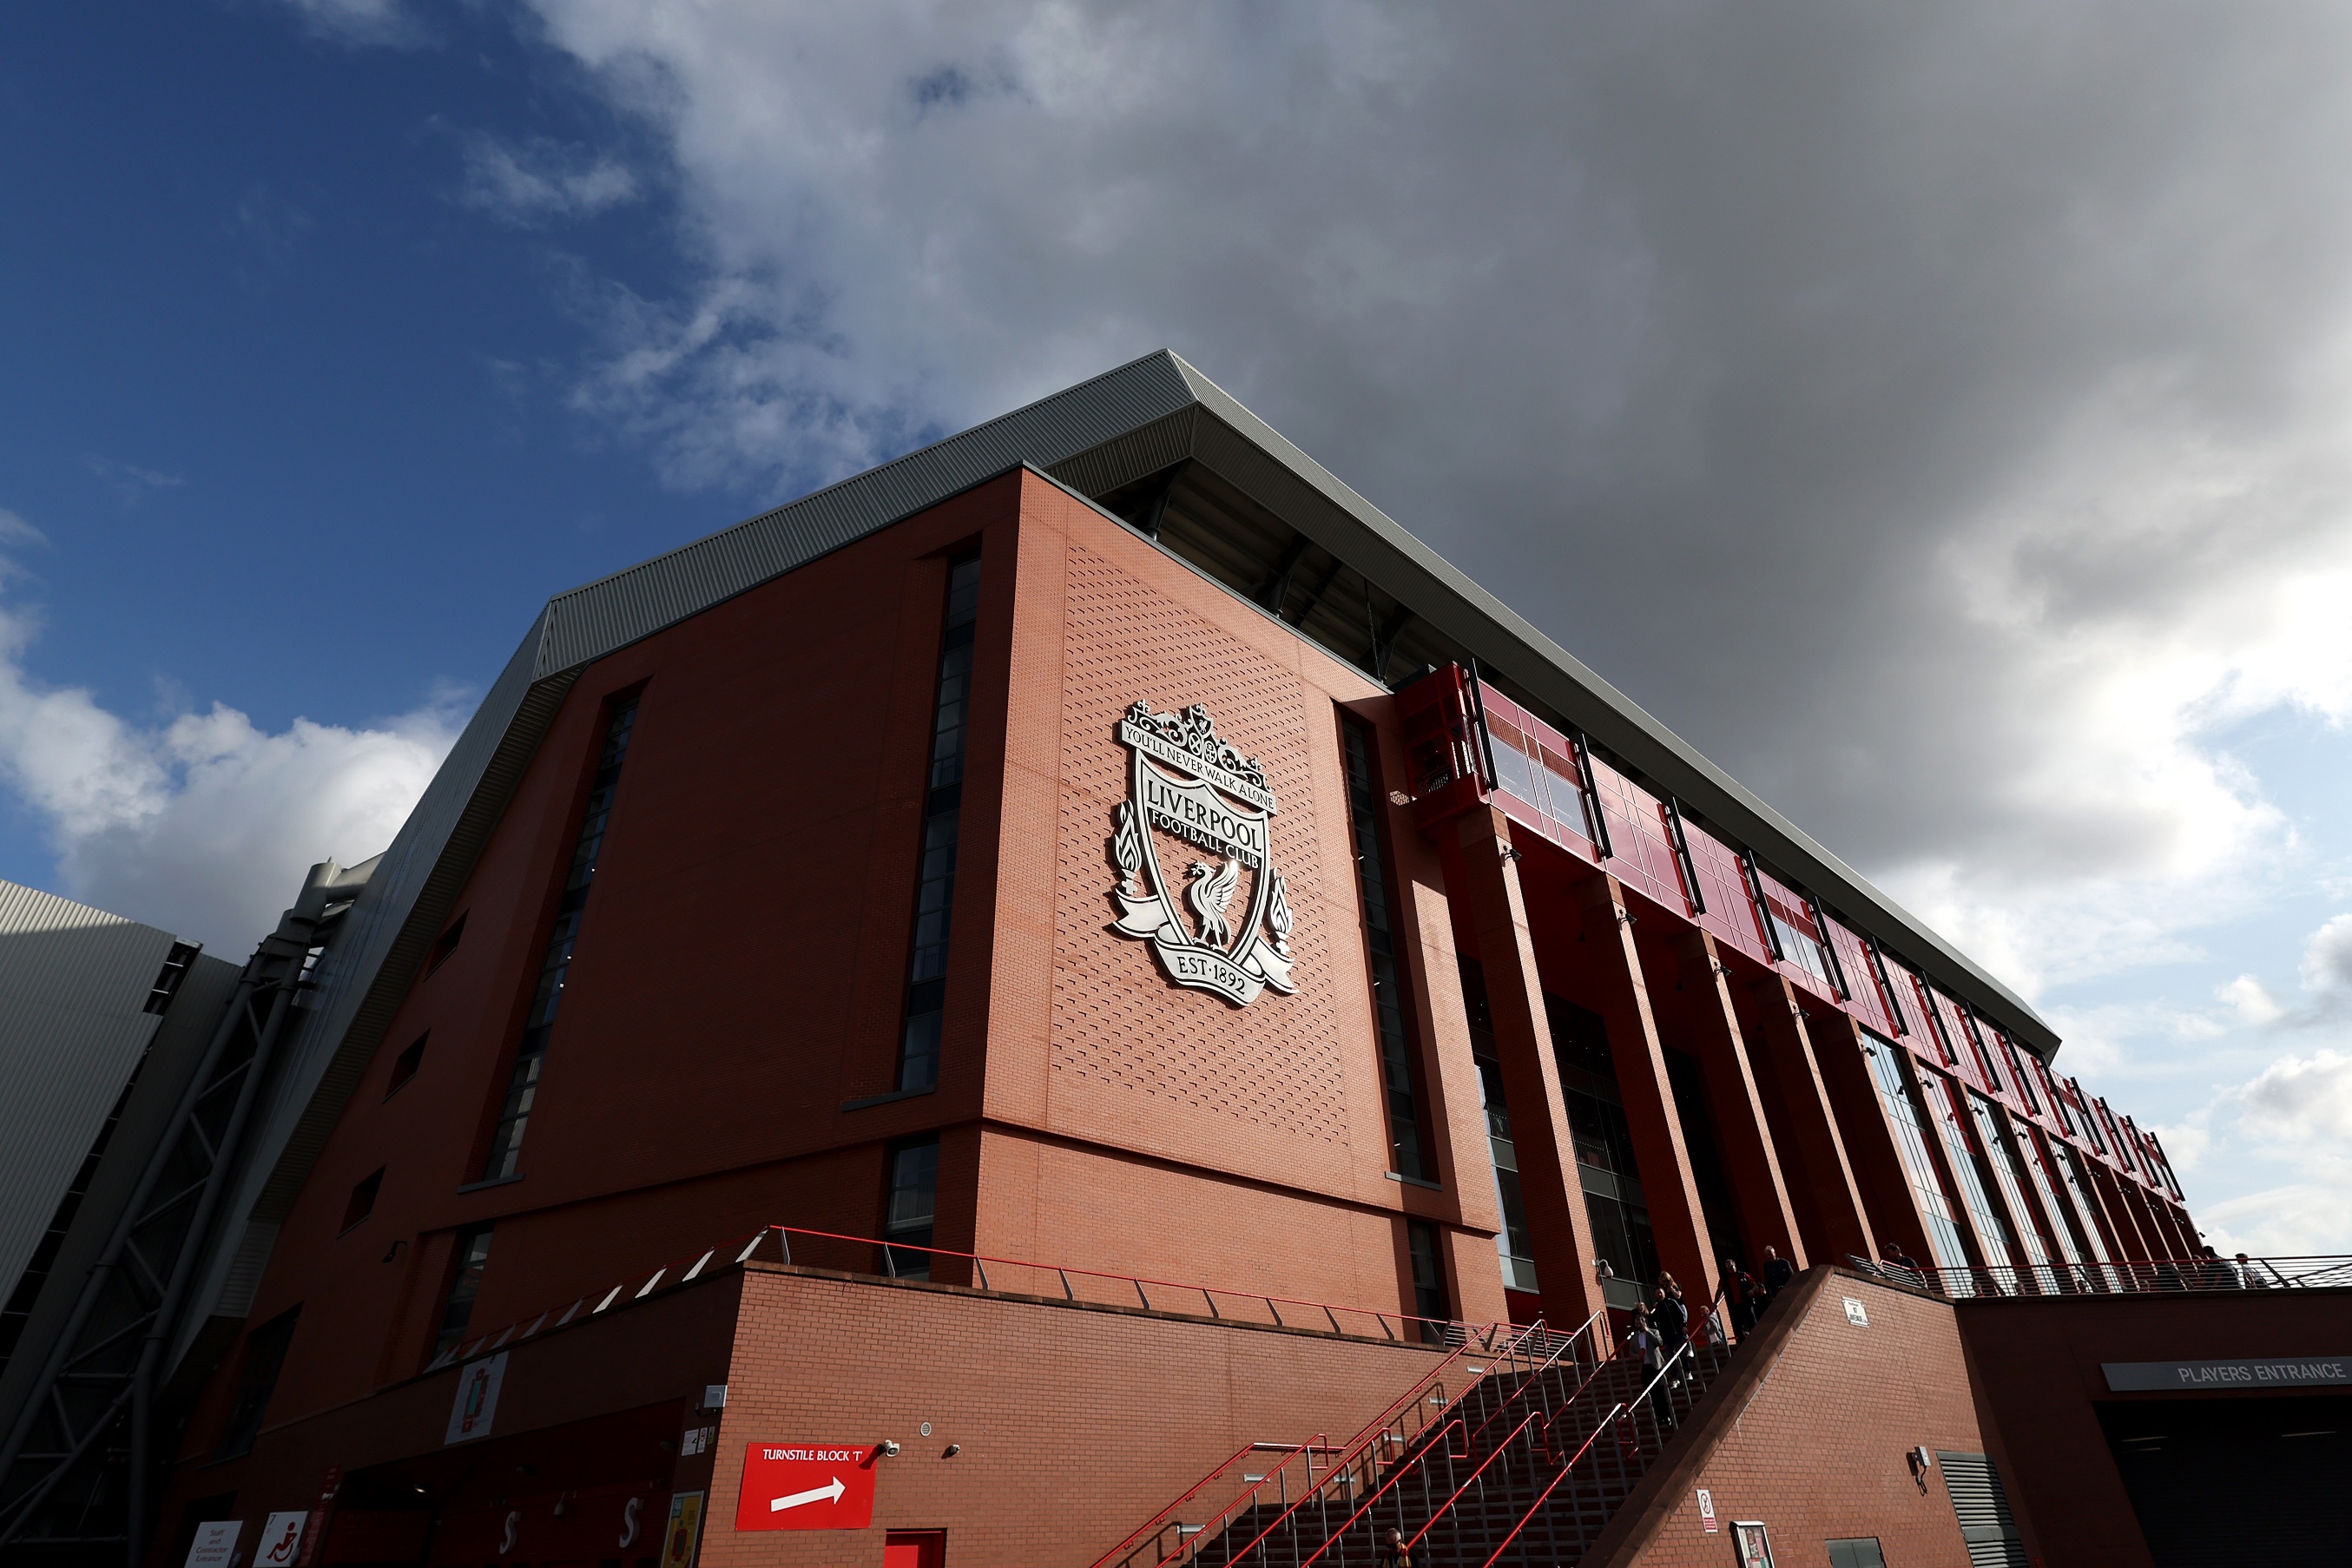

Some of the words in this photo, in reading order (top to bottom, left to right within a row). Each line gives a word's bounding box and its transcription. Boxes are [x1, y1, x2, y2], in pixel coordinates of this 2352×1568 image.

[1125, 726, 1164, 755] YOU'LL
[1167, 747, 1204, 775] NEVER
[1205, 766, 1236, 791] WALK
[1239, 784, 1274, 809] ALONE
[1148, 780, 1262, 853] LIVERPOOL
[1152, 810, 1222, 853] FOOTBALL
[1226, 844, 1259, 869] CLUB
[2177, 1366, 2252, 1382] PLAYERS
[2254, 1363, 2347, 1380] ENTRANCE
[762, 1448, 814, 1460] TURNSTILE
[817, 1450, 850, 1461] BLOCK
[269, 1515, 277, 1525] 7
[498, 1510, 521, 1554] S
[619, 1497, 644, 1548] S
